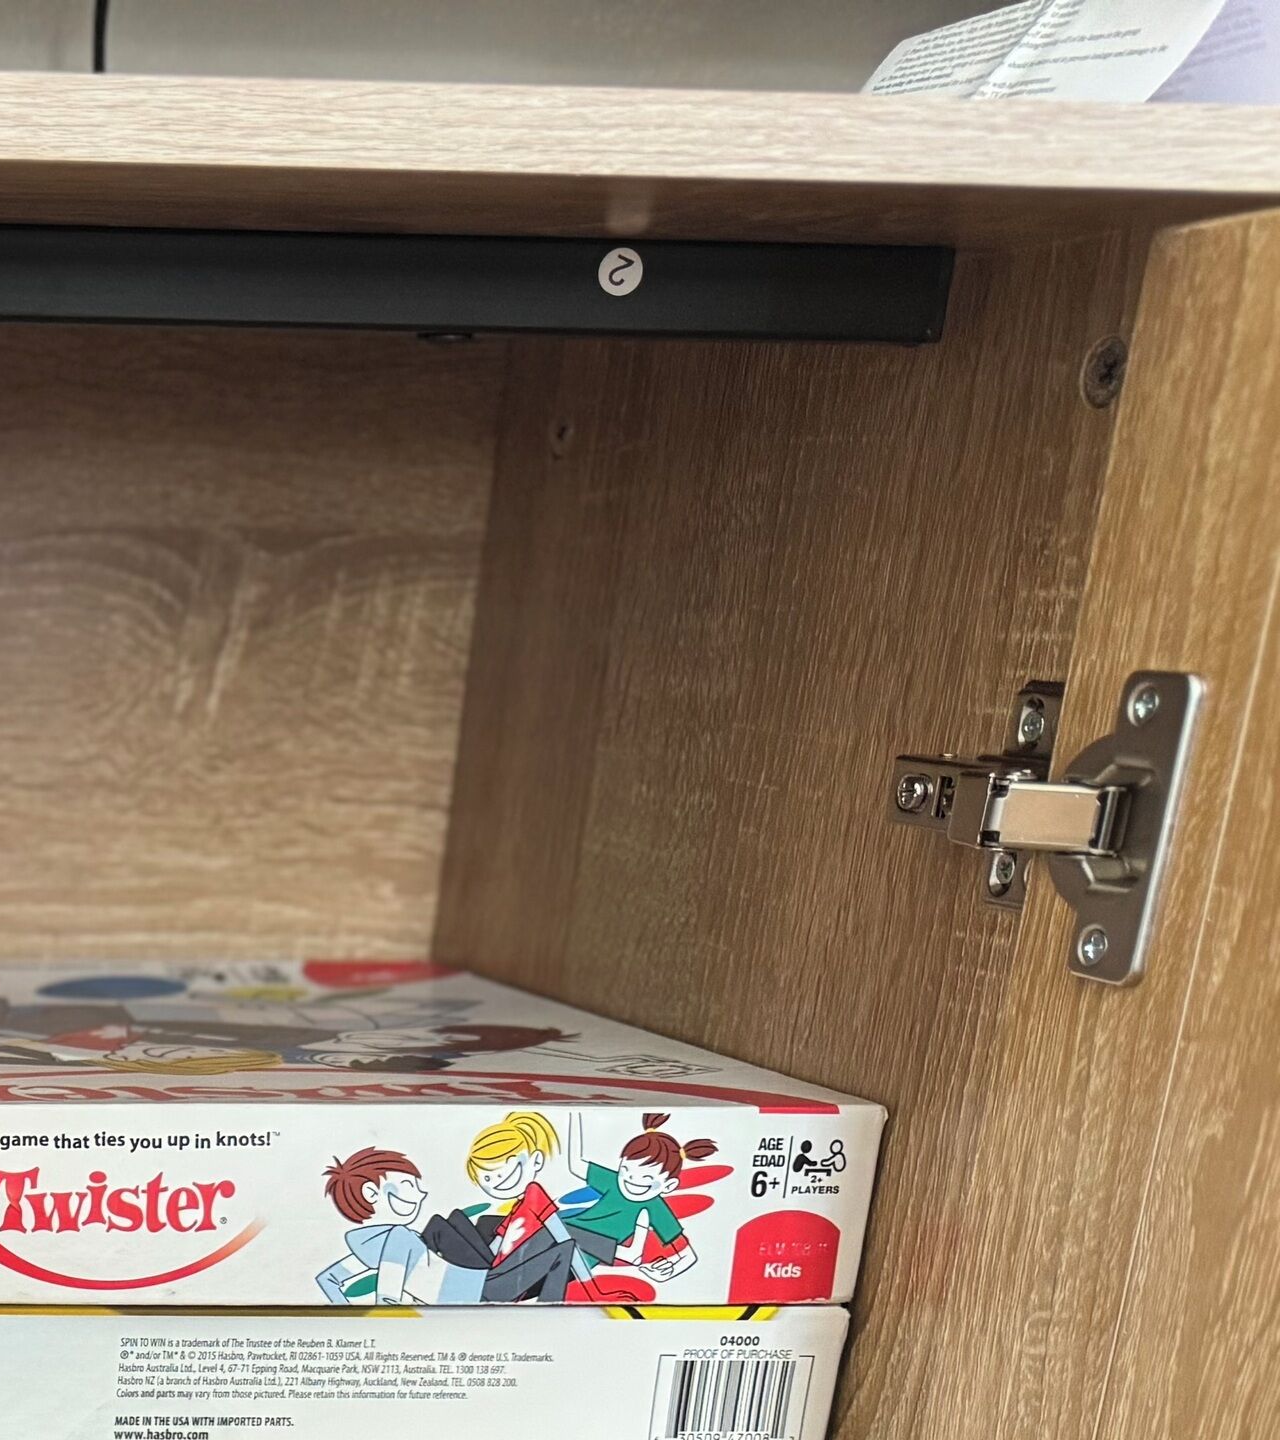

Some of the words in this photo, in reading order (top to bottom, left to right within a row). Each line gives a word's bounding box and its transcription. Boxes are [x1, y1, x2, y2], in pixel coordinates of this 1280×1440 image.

[608, 254, 634, 286] 2
[0, 1133, 49, 1150] game
[54, 1134, 90, 1149] that
[93, 1131, 126, 1148] ties
[130, 1136, 163, 1153] you
[168, 1134, 190, 1150] up
[195, 1134, 211, 1149] in
[758, 1138, 784, 1150] AGE
[753, 1155, 785, 1167] EDAD
[751, 1171, 780, 1197] 6+
[811, 1175, 823, 1183] 2+
[791, 1186, 839, 1194] PLAYERS
[764, 1262, 802, 1278] Kids
[720, 1336, 760, 1346] 04000
[683, 1350, 718, 1358] PROOF
[721, 1350, 734, 1358] OF
[737, 1350, 792, 1359] PURCHASE
[115, 1416, 140, 1426] MADE
[142, 1416, 152, 1426] IN
[154, 1416, 170, 1426] THE
[173, 1417, 189, 1426] USA
[192, 1417, 215, 1426] WITH
[217, 1417, 262, 1427] IMPORTED
[265, 1417, 294, 1427] PARTS.
[114, 1429, 209, 1440] www.hasbro.com
